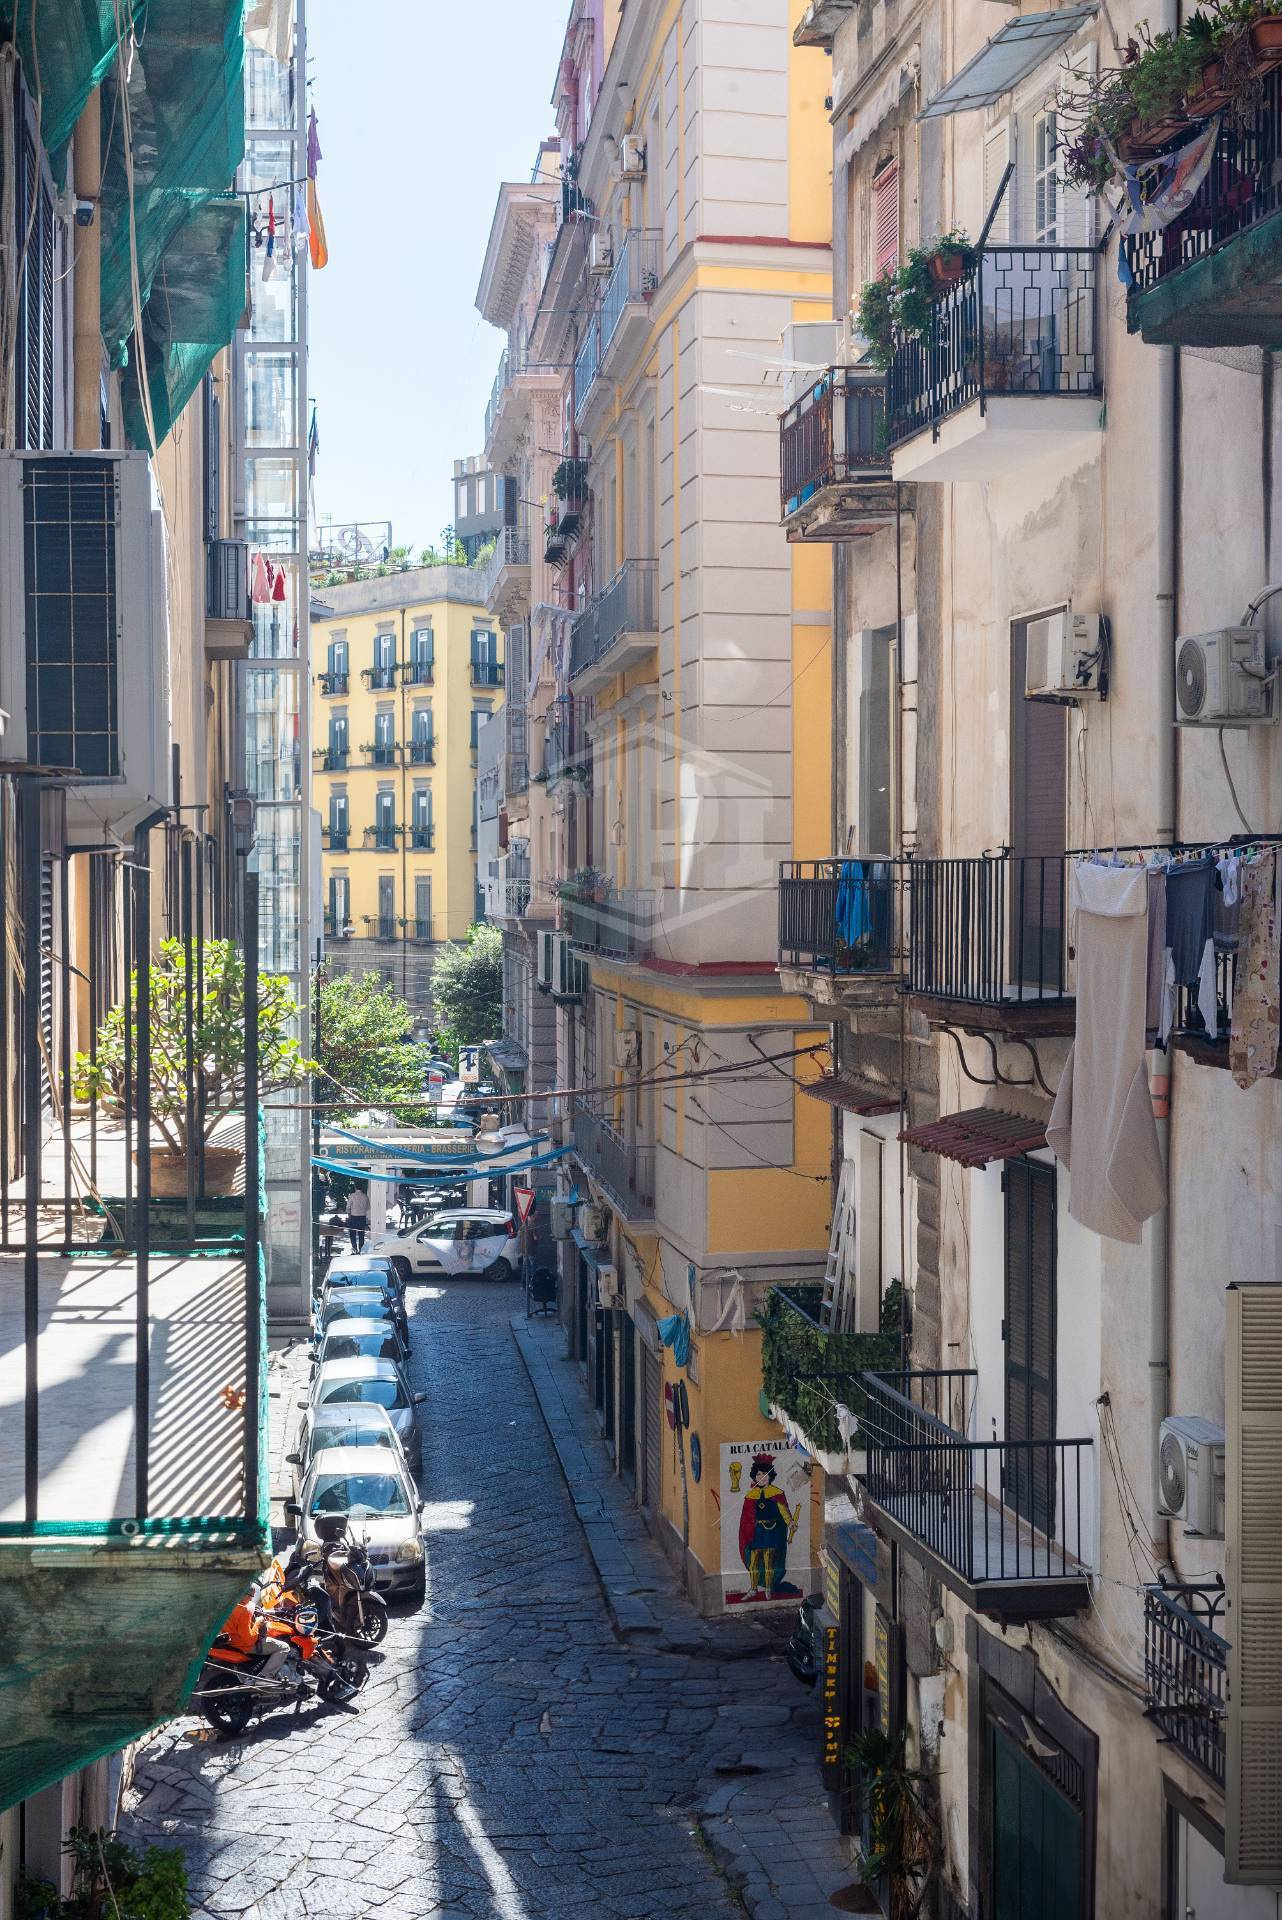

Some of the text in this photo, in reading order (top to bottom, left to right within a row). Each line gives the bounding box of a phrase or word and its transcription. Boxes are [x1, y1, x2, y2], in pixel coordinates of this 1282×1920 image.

[431, 1144, 476, 1154] BRASSERIE
[730, 1441, 797, 1454] RUA CATALA
